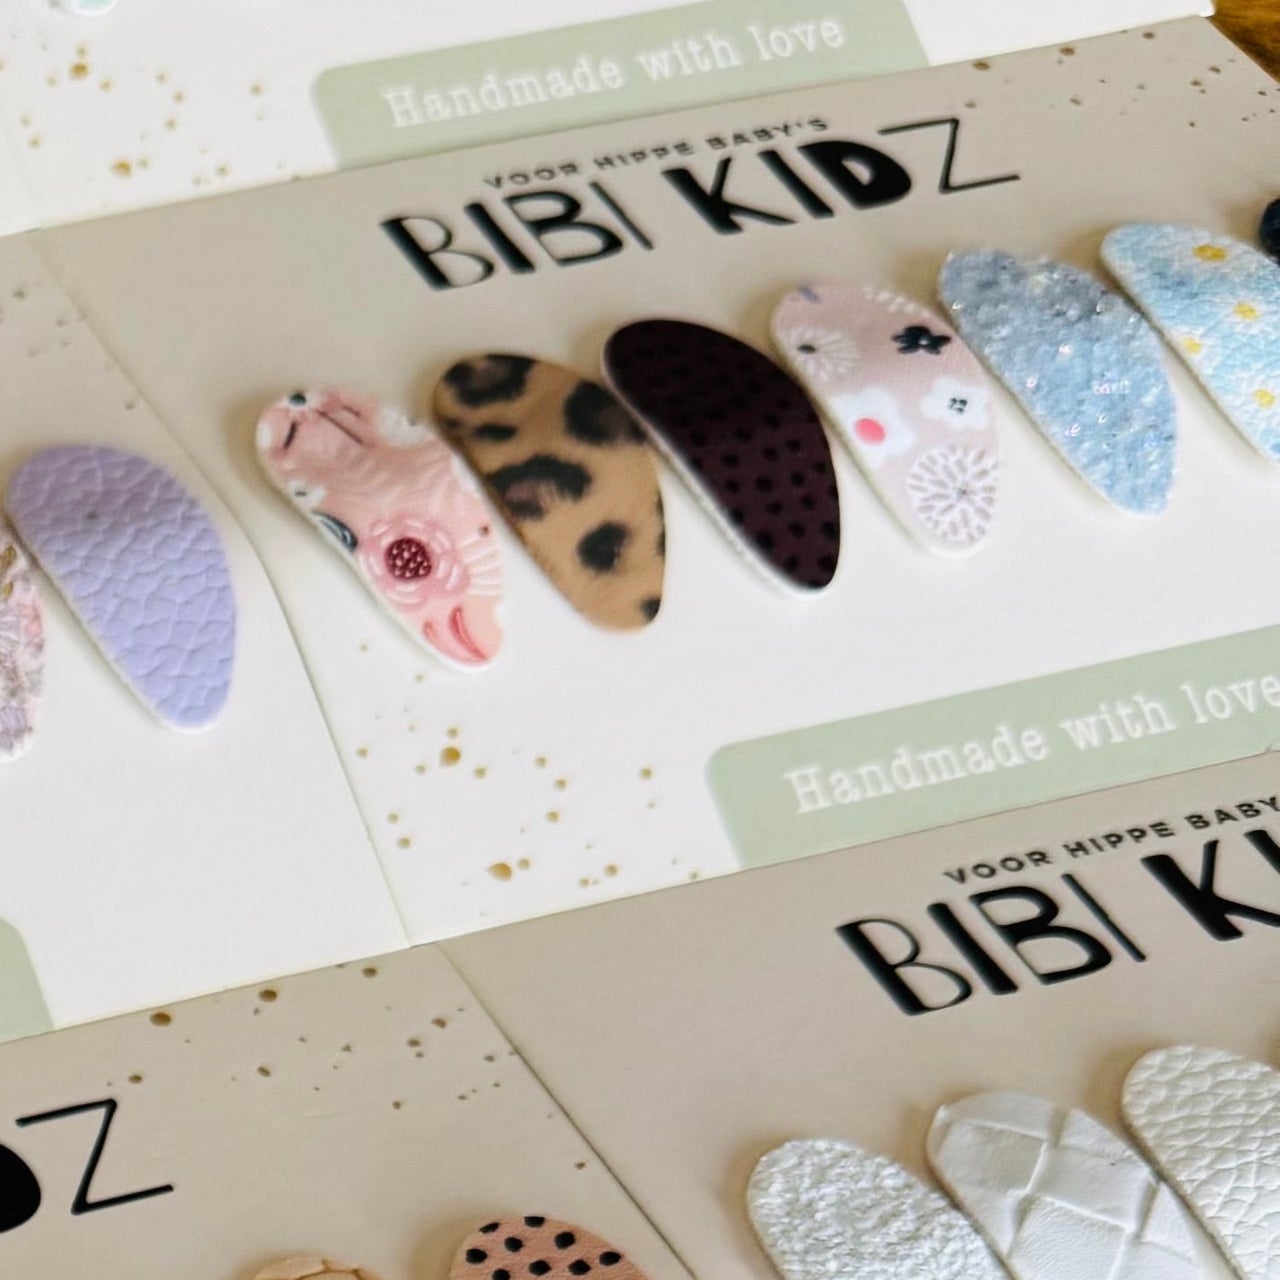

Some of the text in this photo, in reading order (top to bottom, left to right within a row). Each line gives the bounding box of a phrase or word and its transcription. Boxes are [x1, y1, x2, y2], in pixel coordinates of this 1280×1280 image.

[383, 16, 846, 128] Handmade with love
[380, 118, 1021, 291] BIBI KIDZ
[483, 117, 829, 190] VOOR HIPPE BABY'S
[783, 674, 1280, 814] Handmade with love
[943, 796, 1280, 884] VOOR HIPPE BABY
[835, 873, 1146, 1017] BIBI
